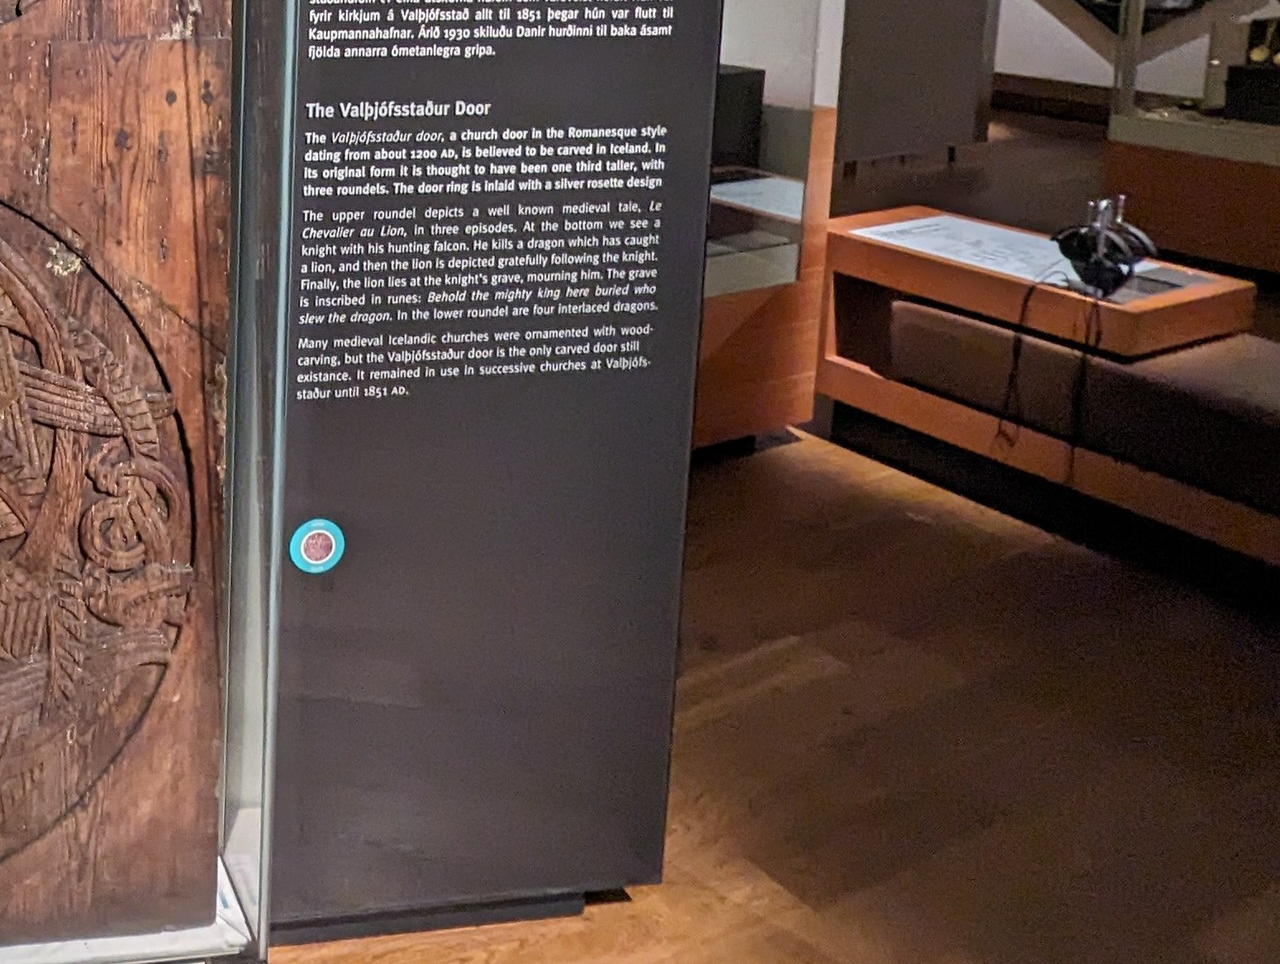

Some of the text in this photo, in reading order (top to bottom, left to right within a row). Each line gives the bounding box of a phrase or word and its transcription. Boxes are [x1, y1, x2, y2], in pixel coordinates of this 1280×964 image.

[308, 44, 496, 60] fjölda annarra ómetanlegra gripa.
[305, 102, 335, 118] The
[455, 101, 492, 116] Door
[305, 132, 327, 144] The
[416, 130, 445, 143] door,
[449, 132, 457, 141] a
[461, 128, 498, 141] church
[502, 128, 529, 140] door
[532, 128, 542, 139] in
[546, 127, 565, 139] the
[568, 127, 637, 140] Romanesque
[641, 125, 668, 139] style
[304, 149, 342, 164] dating
[344, 148, 371, 161] from
[374, 148, 407, 160] about
[410, 150, 438, 159] 1200
[462, 146, 472, 158] is
[475, 145, 522, 158] believed
[525, 146, 537, 157] to
[540, 145, 555, 156] be
[557, 143, 593, 156] carved
[596, 143, 607, 154] in
[610, 142, 652, 154] Iceland.
[655, 142, 666, 153] In
[303, 201, 662, 223] The upper roundel depicts a well known medieval tale, Le
[301, 234, 660, 258] knight with his hunting falcon. He kills a dragon which has caught
[301, 278, 339, 292] Finally,
[343, 278, 361, 289] the
[364, 277, 385, 288] lion
[388, 276, 407, 288] lies
[410, 276, 421, 287] at
[424, 275, 442, 286] the
[491, 274, 524, 286] grave,
[527, 270, 578, 283] mourning
[580, 269, 603, 280] him.
[608, 268, 626, 279] The
[628, 269, 658, 281] grave
[298, 338, 329, 351] Many
[333, 335, 383, 348] medieval
[388, 333, 437, 346] Icelandic
[441, 331, 490, 344] churches
[494, 332, 521, 341] were
[525, 327, 589, 340] ornamented
[593, 325, 616, 337] with
[297, 387, 331, 400] staður
[334, 386, 360, 398] until
[364, 386, 388, 398] 1851
